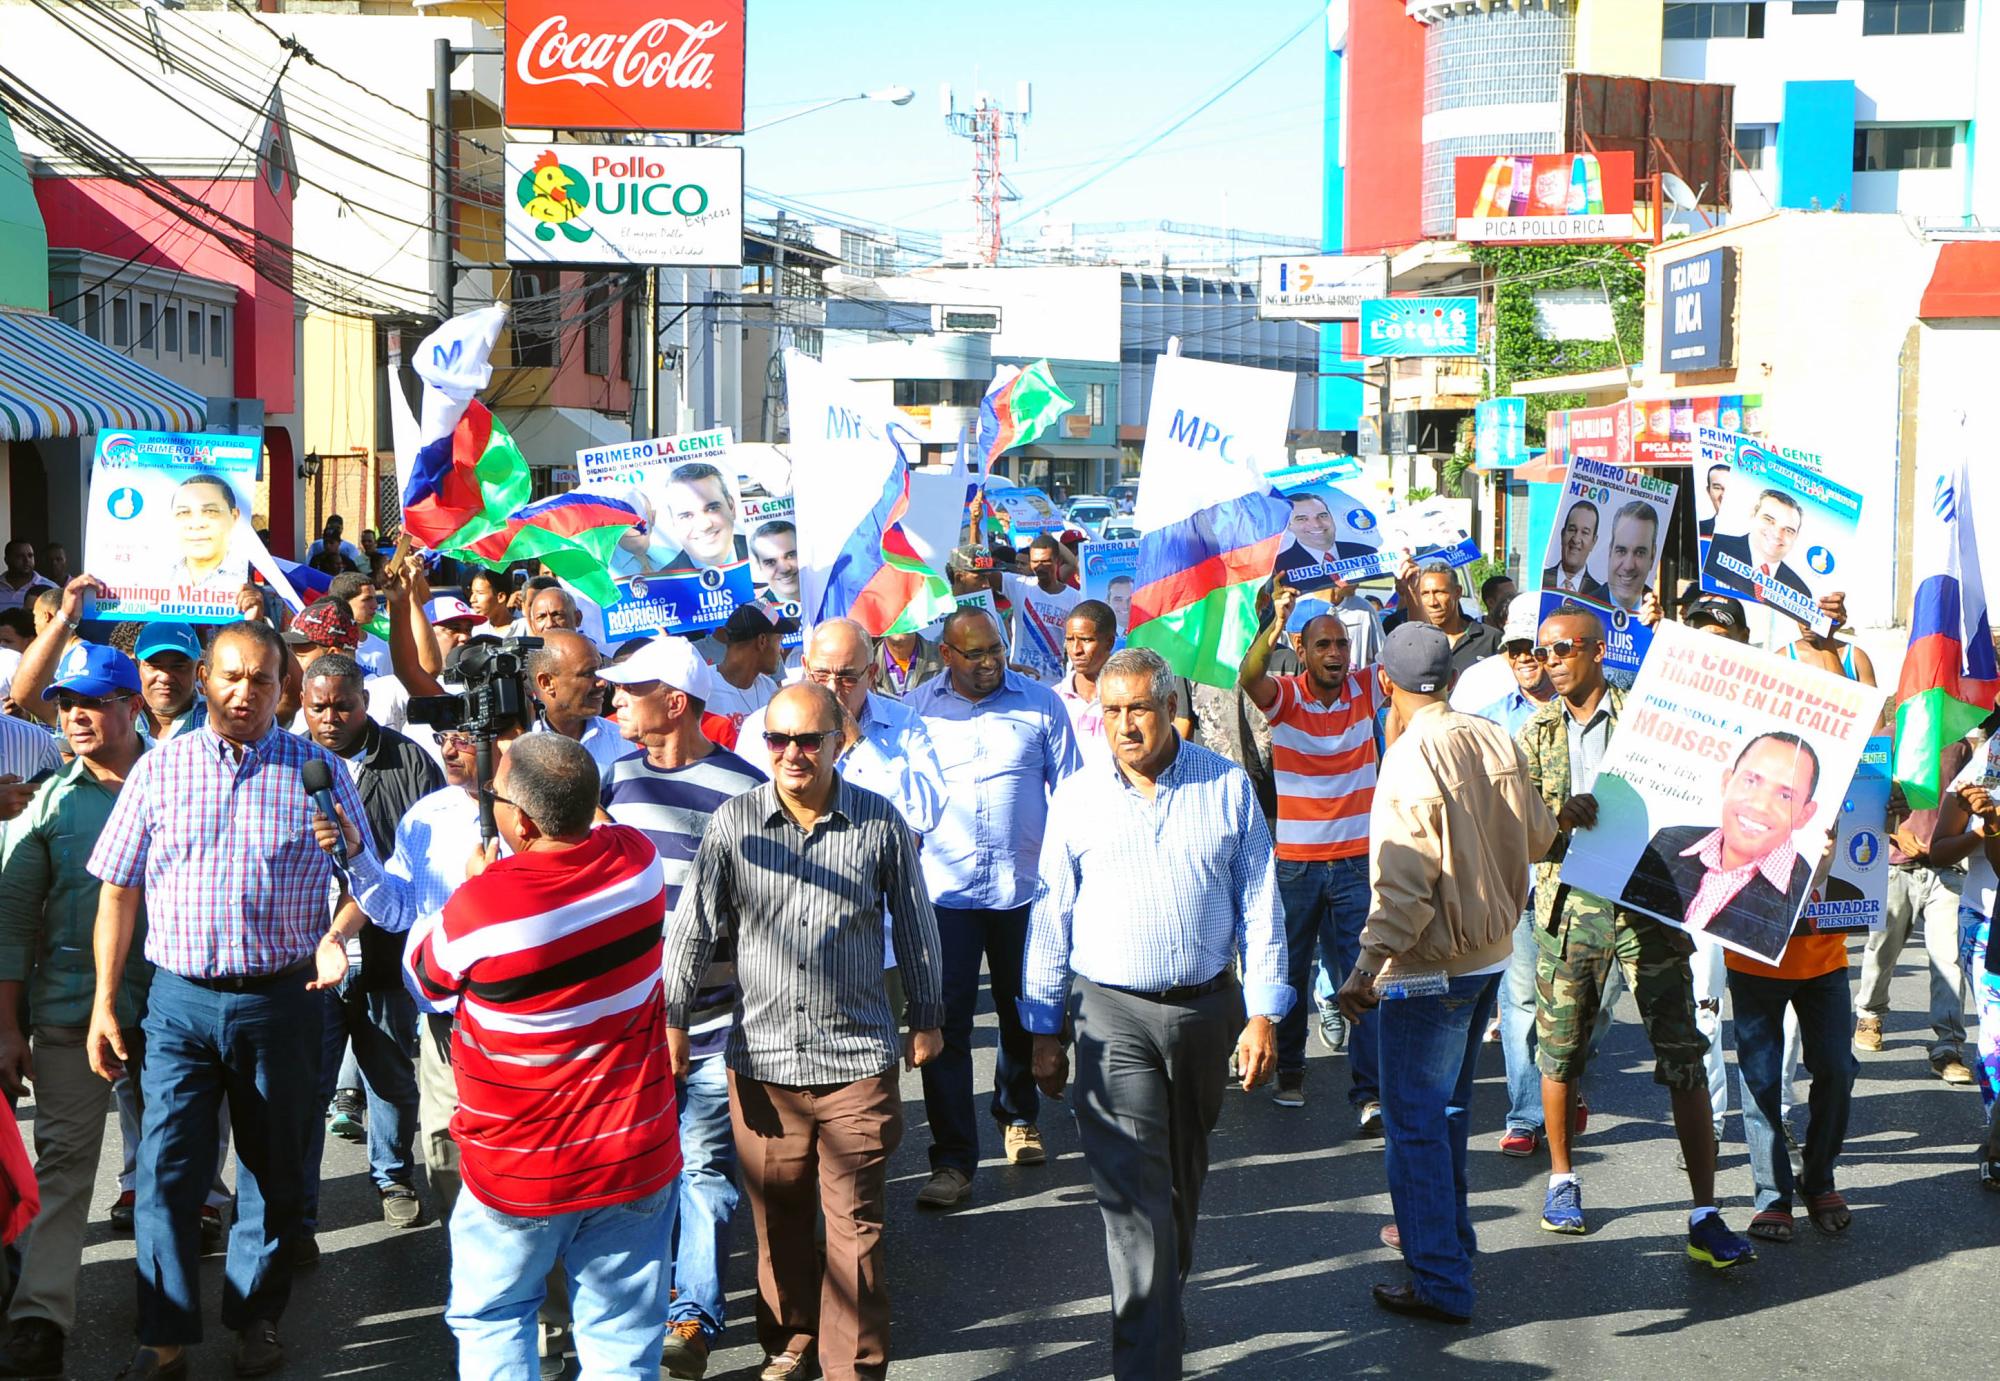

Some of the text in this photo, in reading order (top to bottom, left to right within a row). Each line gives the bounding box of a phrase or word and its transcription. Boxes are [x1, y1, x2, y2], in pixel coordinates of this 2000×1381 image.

[516, 15, 728, 90] Coca-Cola
[592, 156, 665, 178] Pollo
[595, 182, 709, 216] UICO
[1485, 219, 1605, 236] PICA POLLO RICA
[1674, 292, 1702, 334] RICA
[138, 443, 192, 455] PRIMERO
[194, 446, 209, 456] LA
[584, 433, 725, 467] PRIMERO LA GENTE
[668, 452, 703, 464] BIENESTAR
[704, 448, 727, 458] SOCIAL
[1641, 443, 1670, 452] PICA
[1782, 447, 1823, 466] GENTE
[1575, 456, 1673, 496] PRIMERO LA GENTE
[744, 505, 760, 516] LA
[1083, 542, 1123, 553] PRIMERO
[1288, 551, 1398, 582] LUIS ABINADER
[95, 584, 171, 605] Domingo
[1719, 552, 1825, 618] LUIS ABINADER
[698, 588, 733, 609] LUIS
[1762, 589, 1822, 626] PRESIDENTE
[161, 604, 235, 616] DIPUTADO
[607, 602, 679, 631] RODRIGUEZ
[1607, 630, 1634, 650] LUIS
[1742, 688, 1769, 711] EN
[1769, 695, 1792, 720] LA
[1795, 706, 1855, 741] CALLE
[1631, 708, 1731, 763] Moises
[1733, 725, 1743, 735] A
[1806, 900, 1880, 917] ABINADER
[1817, 915, 1878, 928] PRESIDENTE
